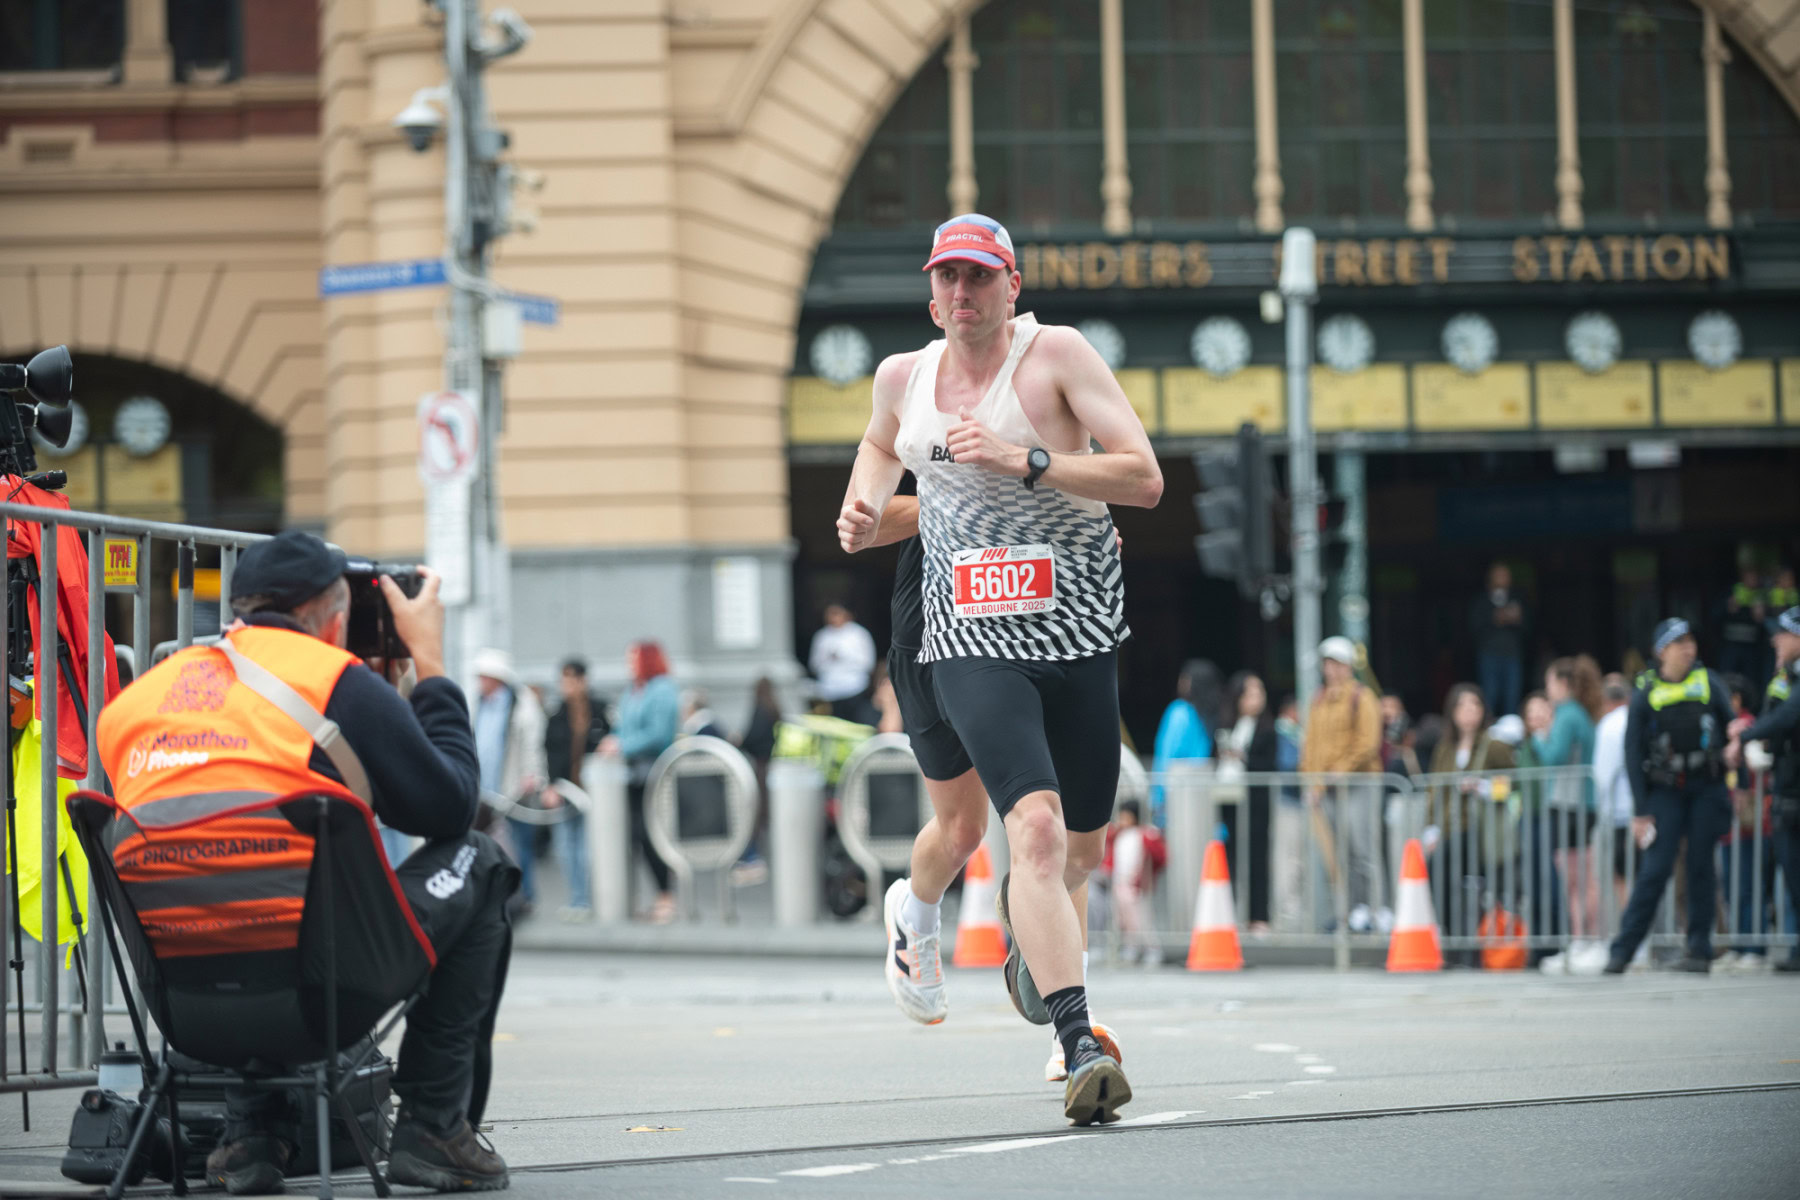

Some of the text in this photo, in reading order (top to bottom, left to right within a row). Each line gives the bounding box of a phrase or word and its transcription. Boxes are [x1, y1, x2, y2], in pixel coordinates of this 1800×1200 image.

[945, 232, 984, 243] FRACTEL
[1023, 240, 1214, 289] INDERS
[1512, 234, 1731, 283] STATION
[970, 562, 1037, 601] 5602
[963, 600, 1046, 616] MELBOURNE 2025
[152, 729, 249, 751] Marathon
[143, 838, 290, 866] PHOTOGRAPHER
